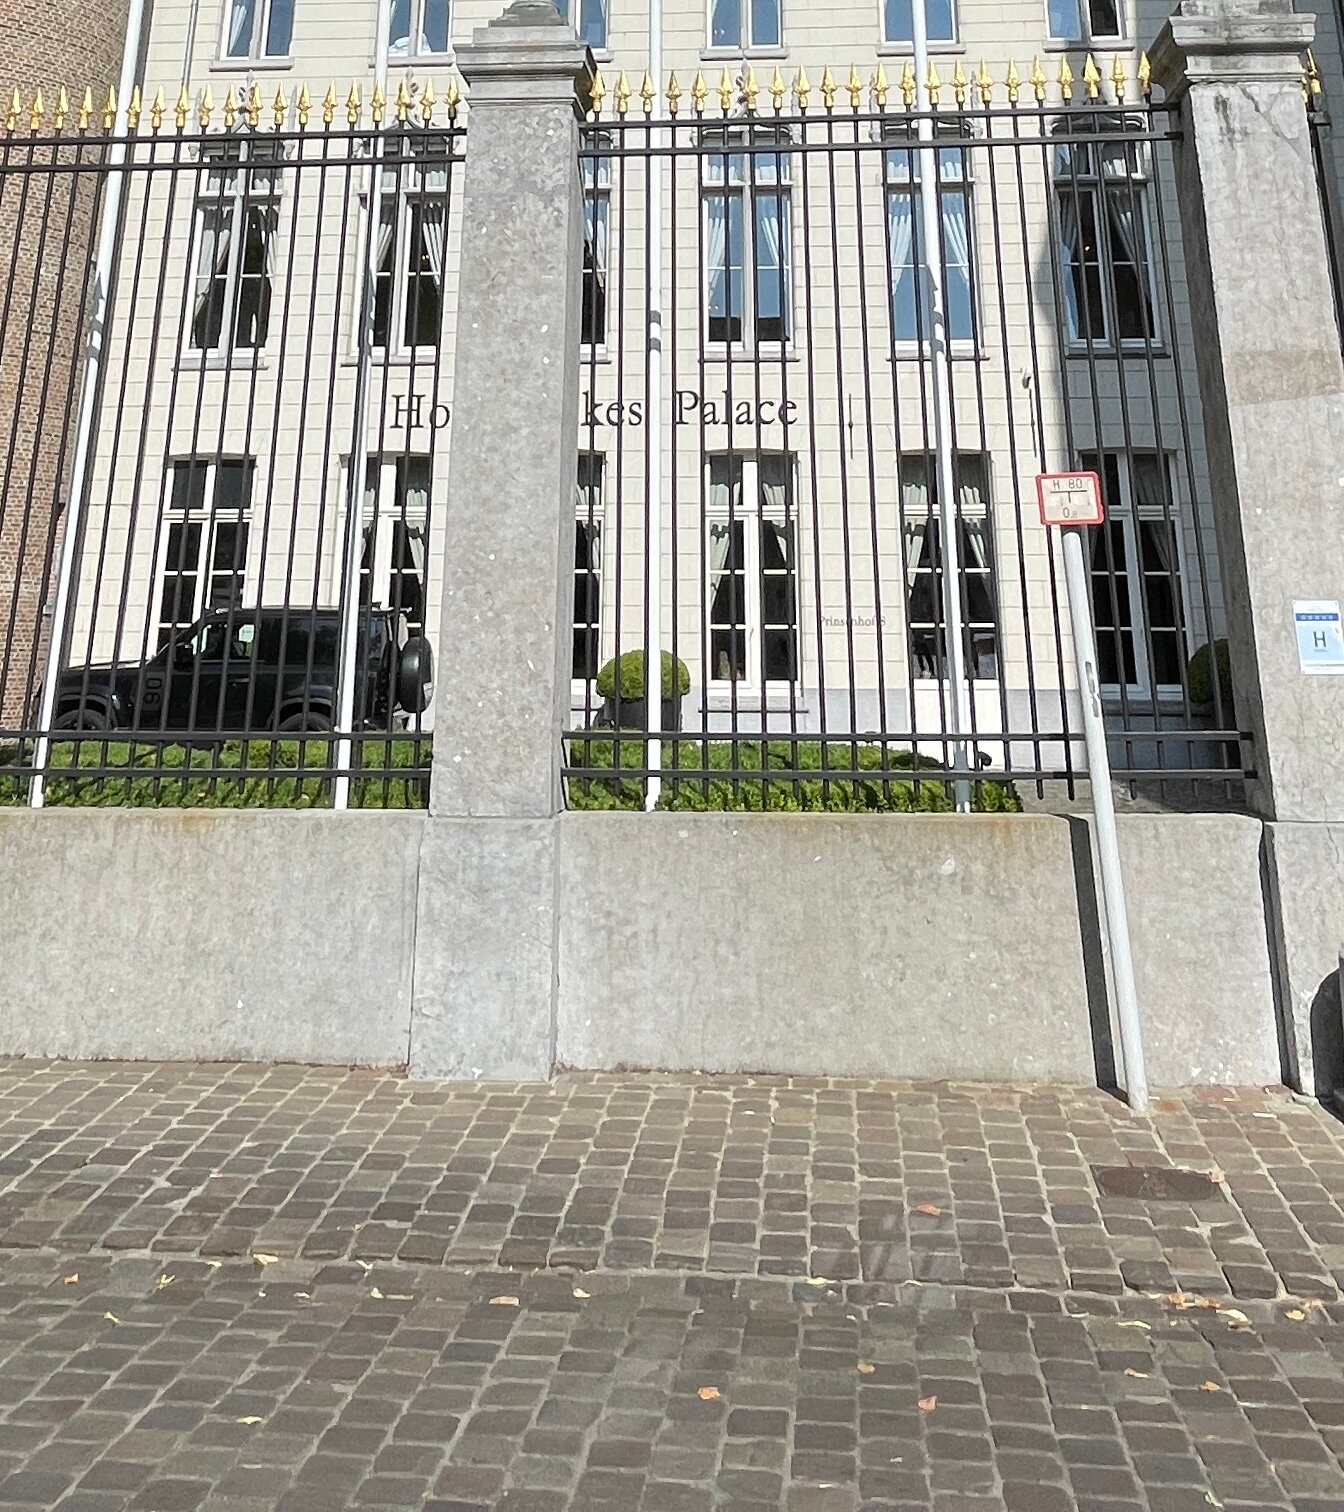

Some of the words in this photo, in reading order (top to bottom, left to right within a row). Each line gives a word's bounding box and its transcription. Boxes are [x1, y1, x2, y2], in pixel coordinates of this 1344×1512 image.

[390, 394, 451, 429] Ho
[580, 390, 643, 427] kes
[673, 390, 798, 426] Palace
[1068, 478, 1083, 489] 80
